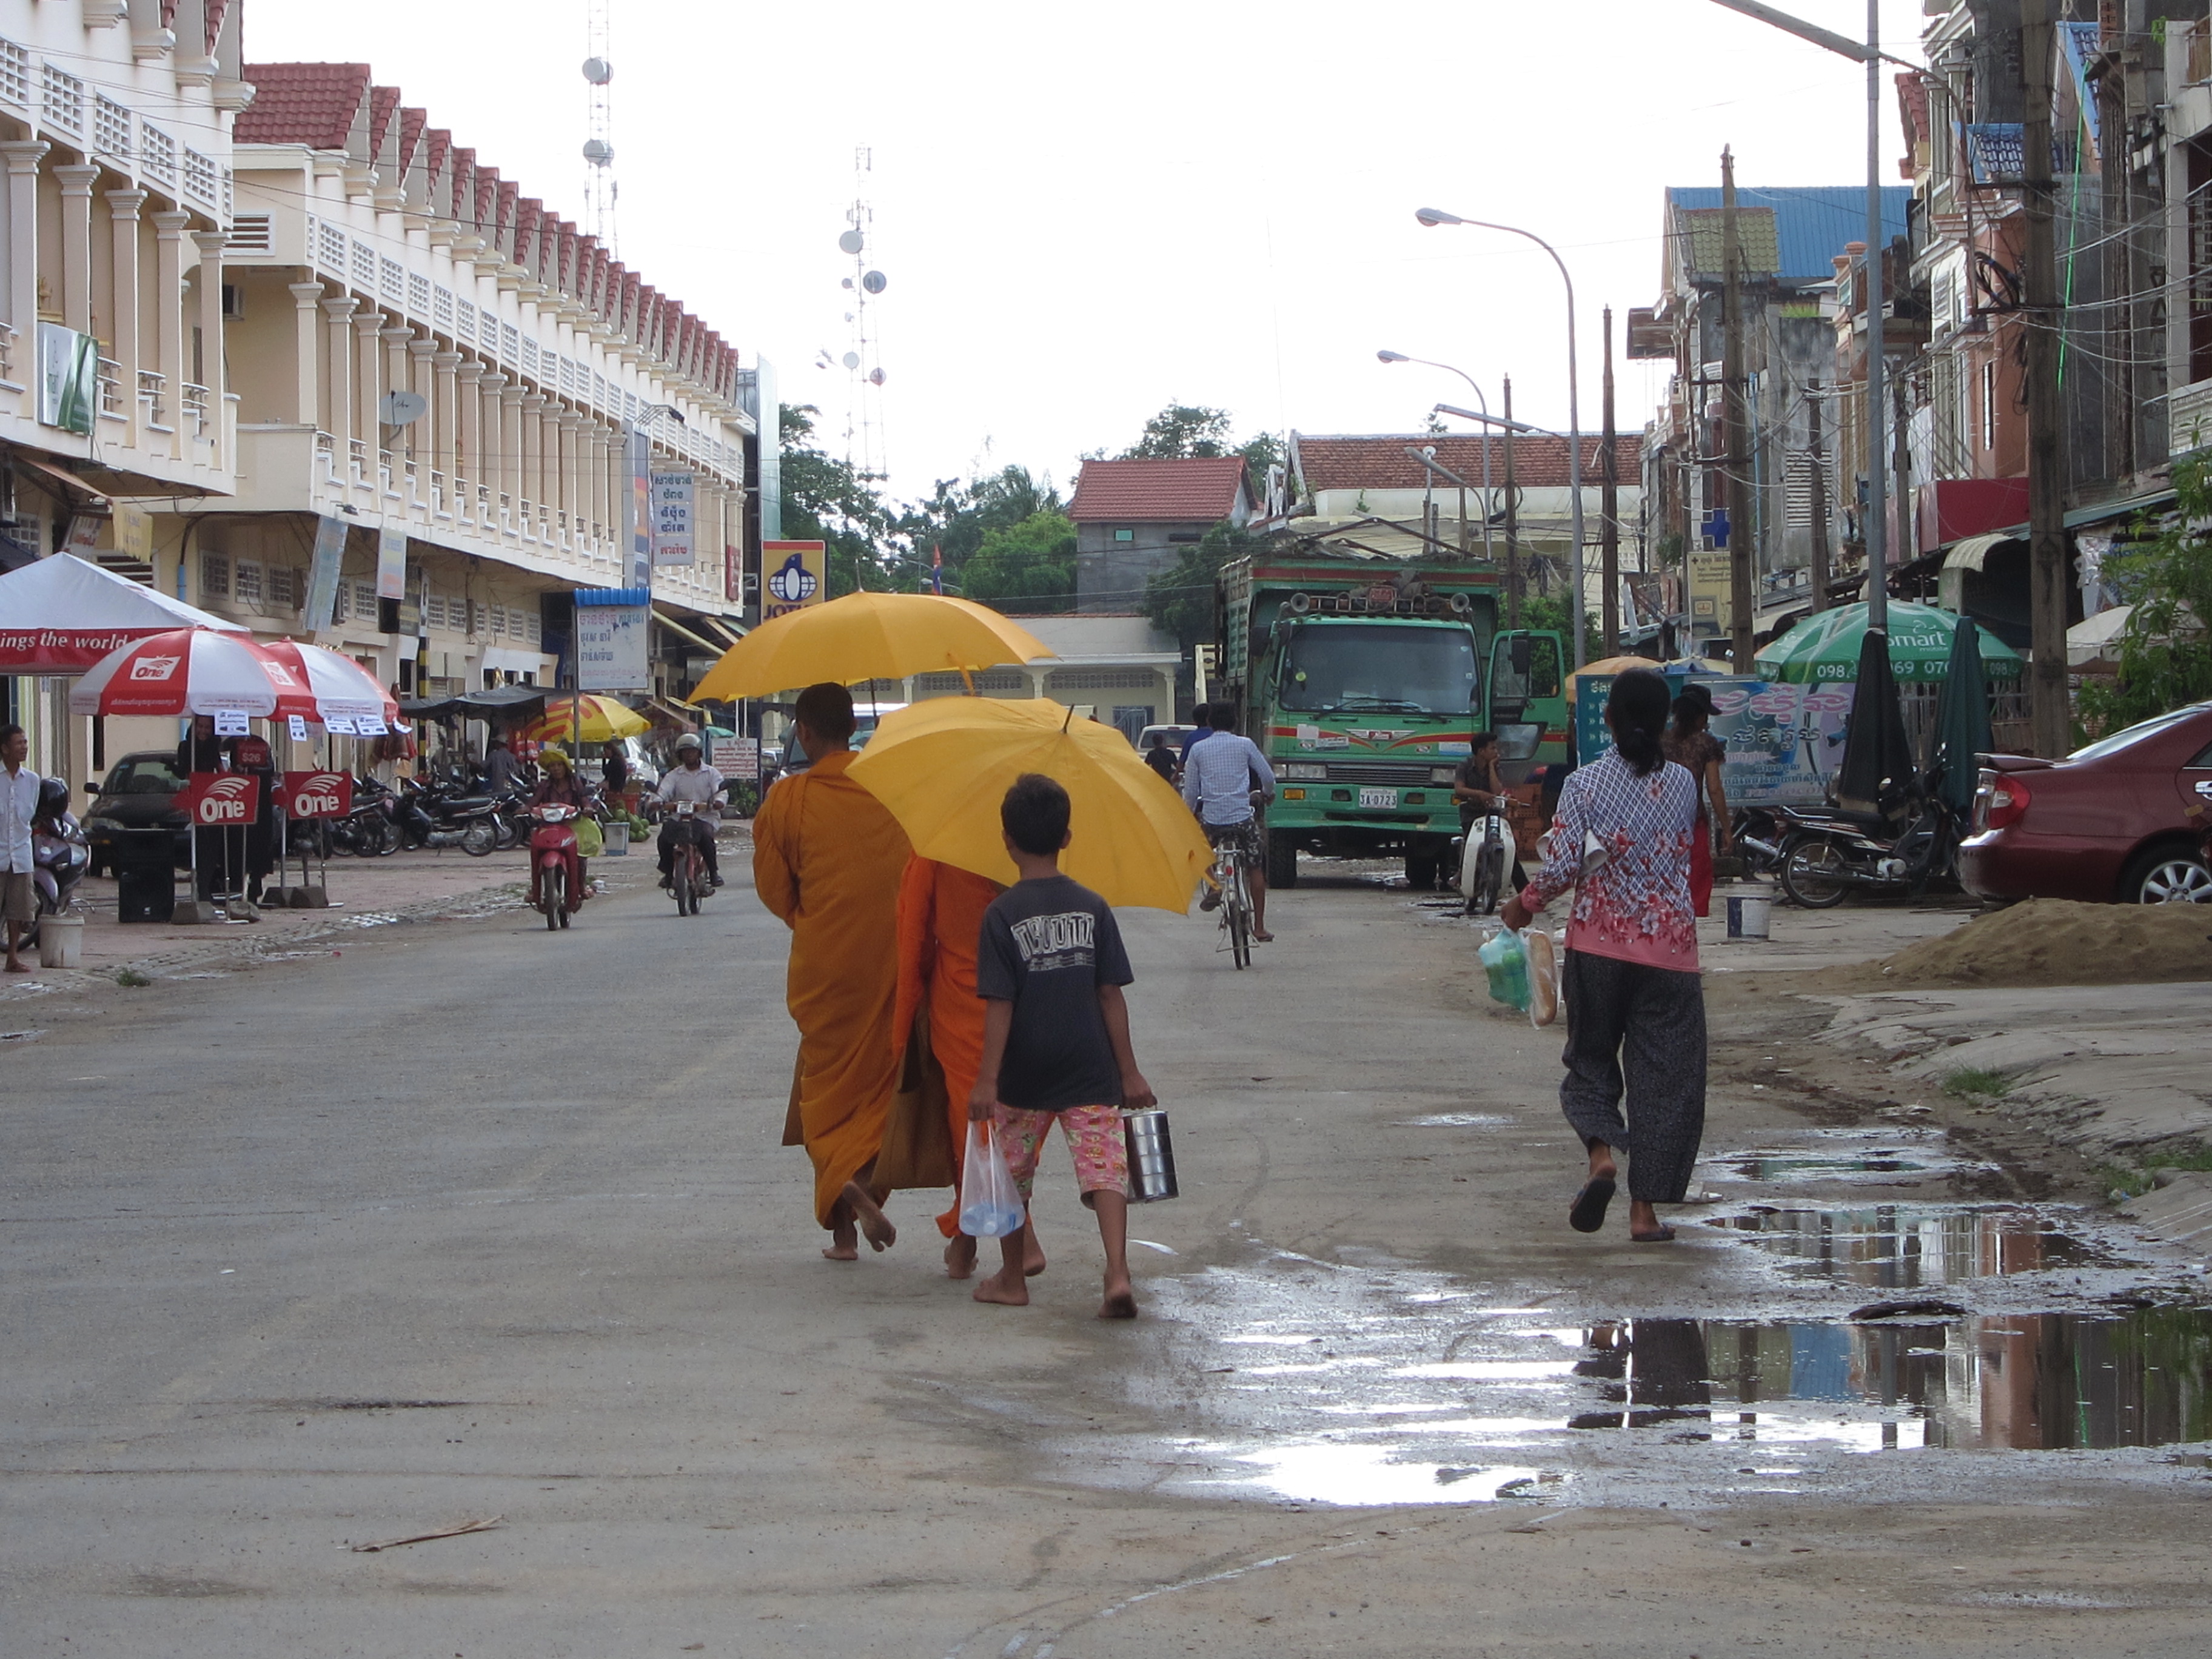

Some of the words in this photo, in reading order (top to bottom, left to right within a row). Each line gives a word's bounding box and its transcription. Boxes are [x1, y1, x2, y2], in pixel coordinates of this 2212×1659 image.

[39, 631, 68, 648] the
[75, 634, 128, 650] world
[135, 667, 165, 678] One
[1890, 662, 1914, 674] 69
[295, 793, 340, 816] One
[1360, 795, 1396, 805] 3A-0723
[199, 797, 245, 822] One
